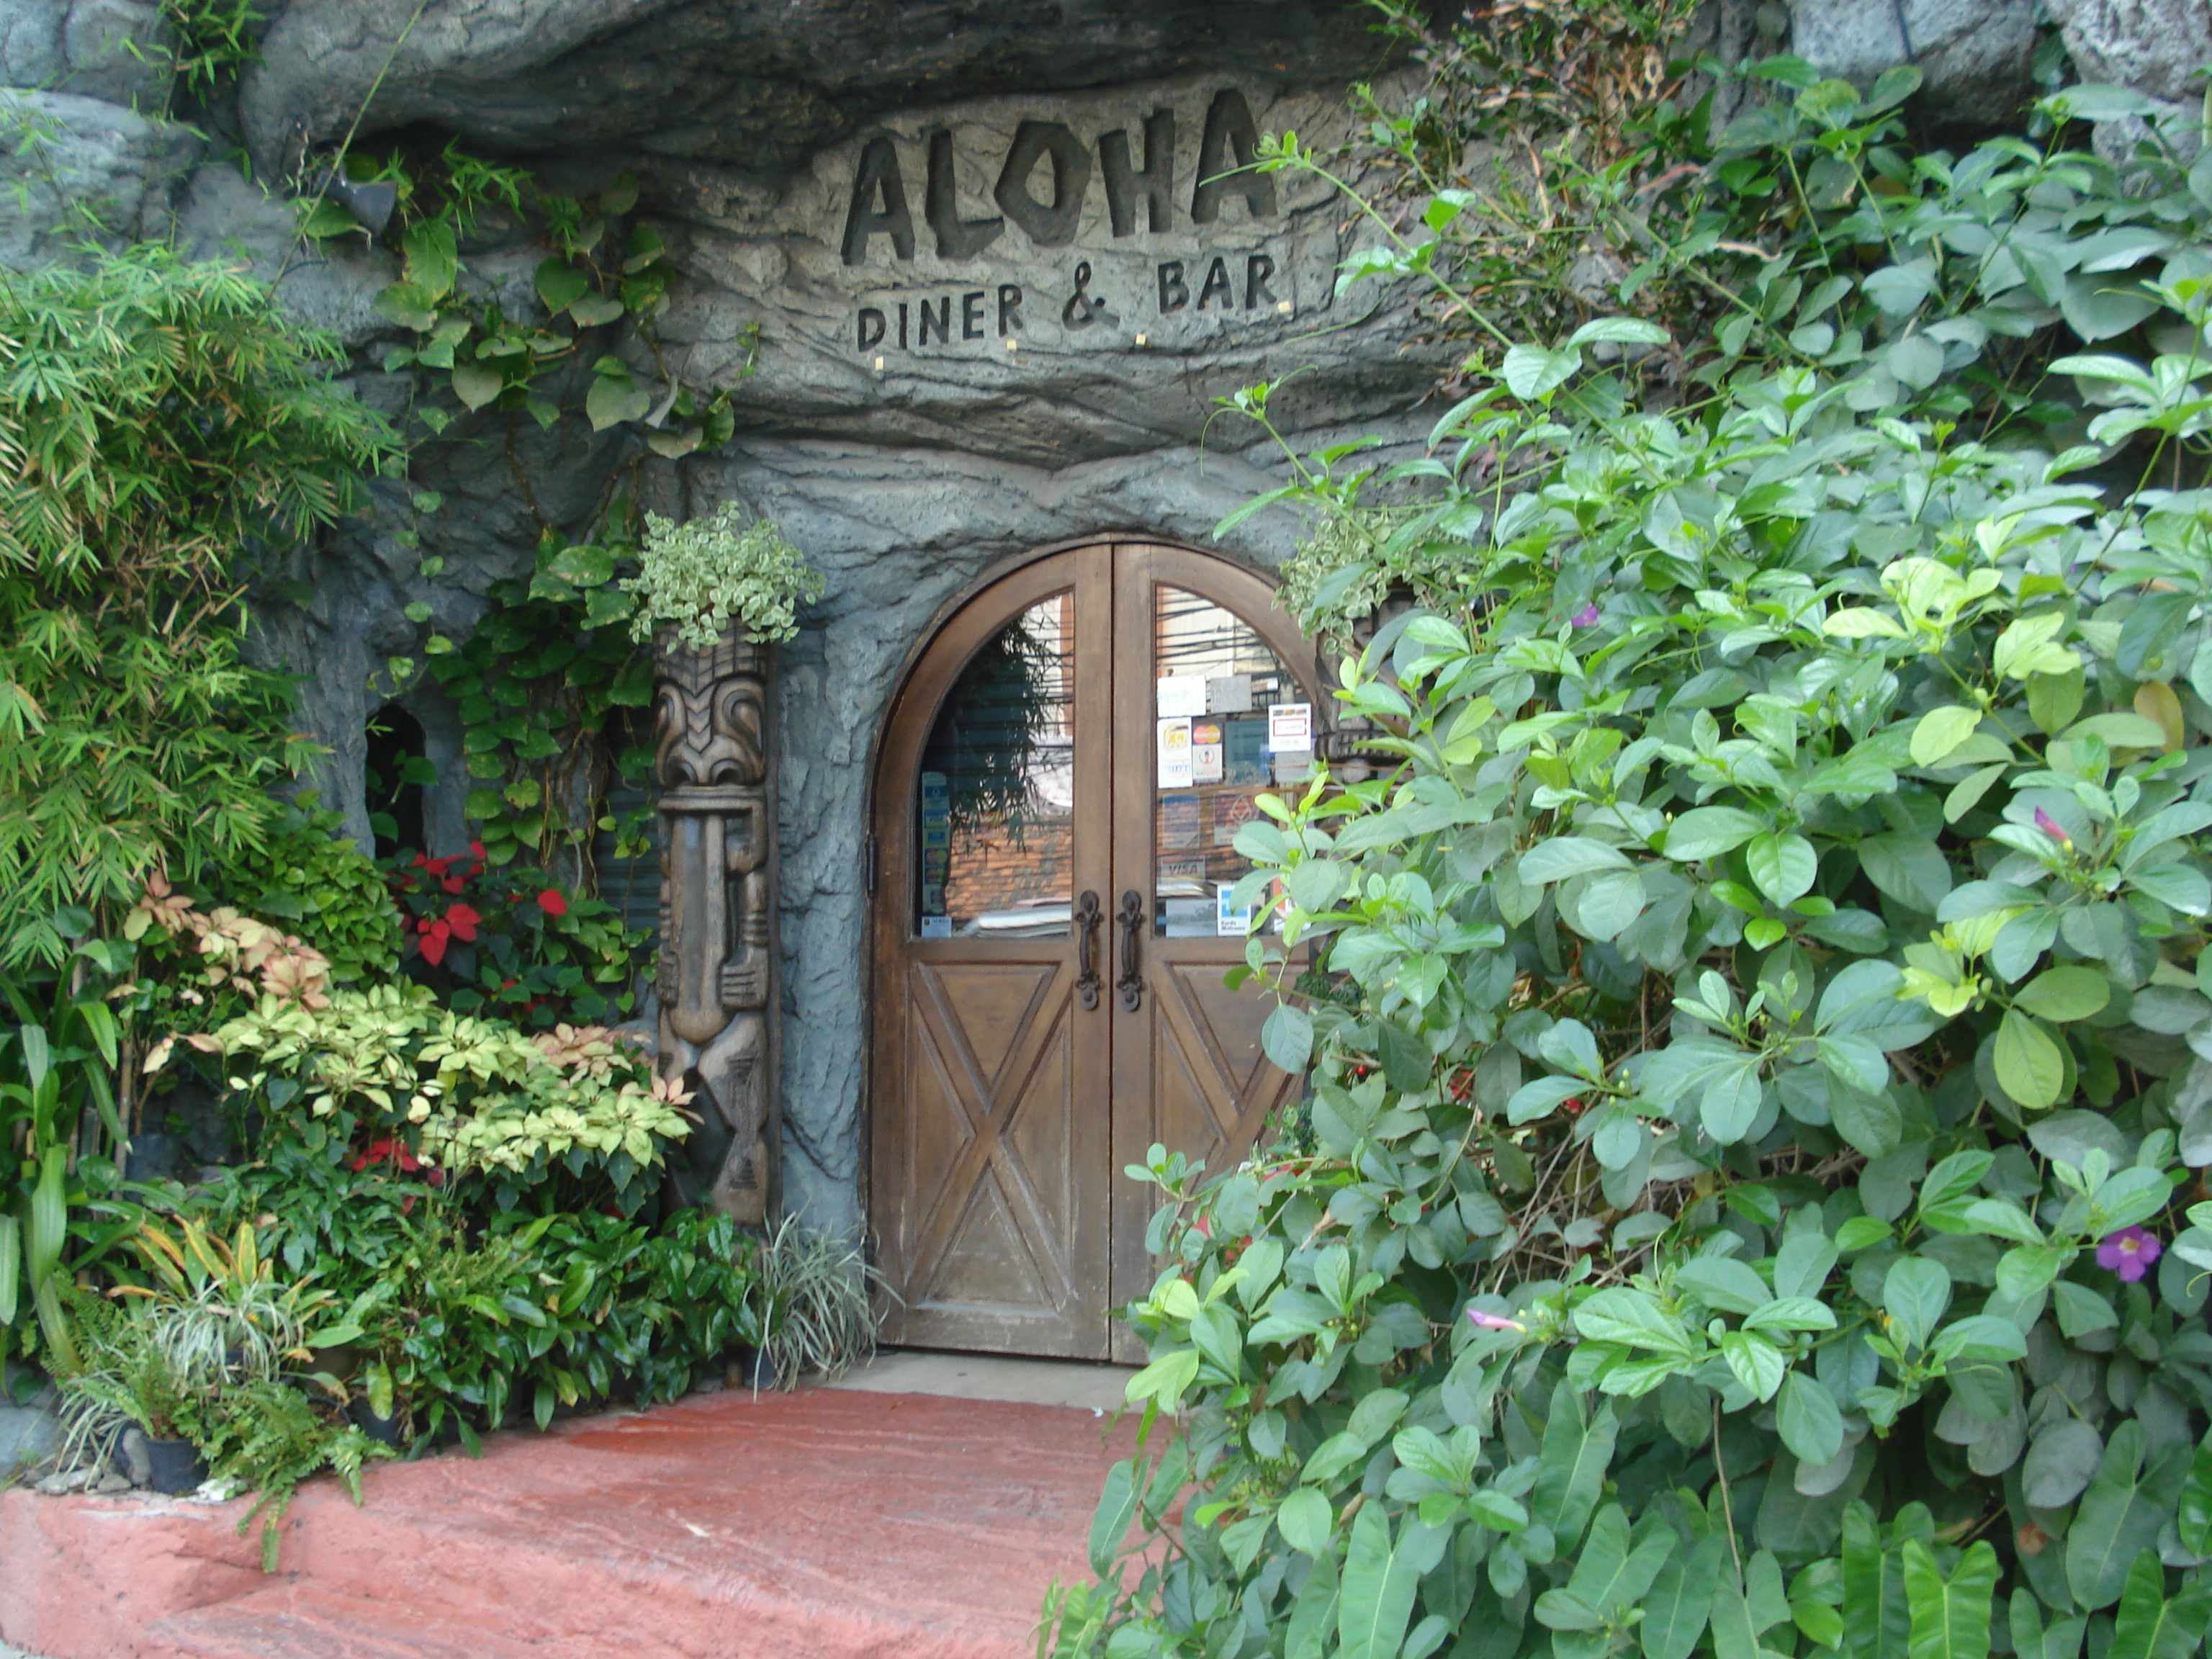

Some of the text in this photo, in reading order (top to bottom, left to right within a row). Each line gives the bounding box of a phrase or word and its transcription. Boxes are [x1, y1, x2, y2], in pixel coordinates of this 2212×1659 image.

[840, 88, 1280, 266] ALOHA
[857, 253, 1277, 353] DINER & BAR
[1169, 863, 1198, 874] VISA
